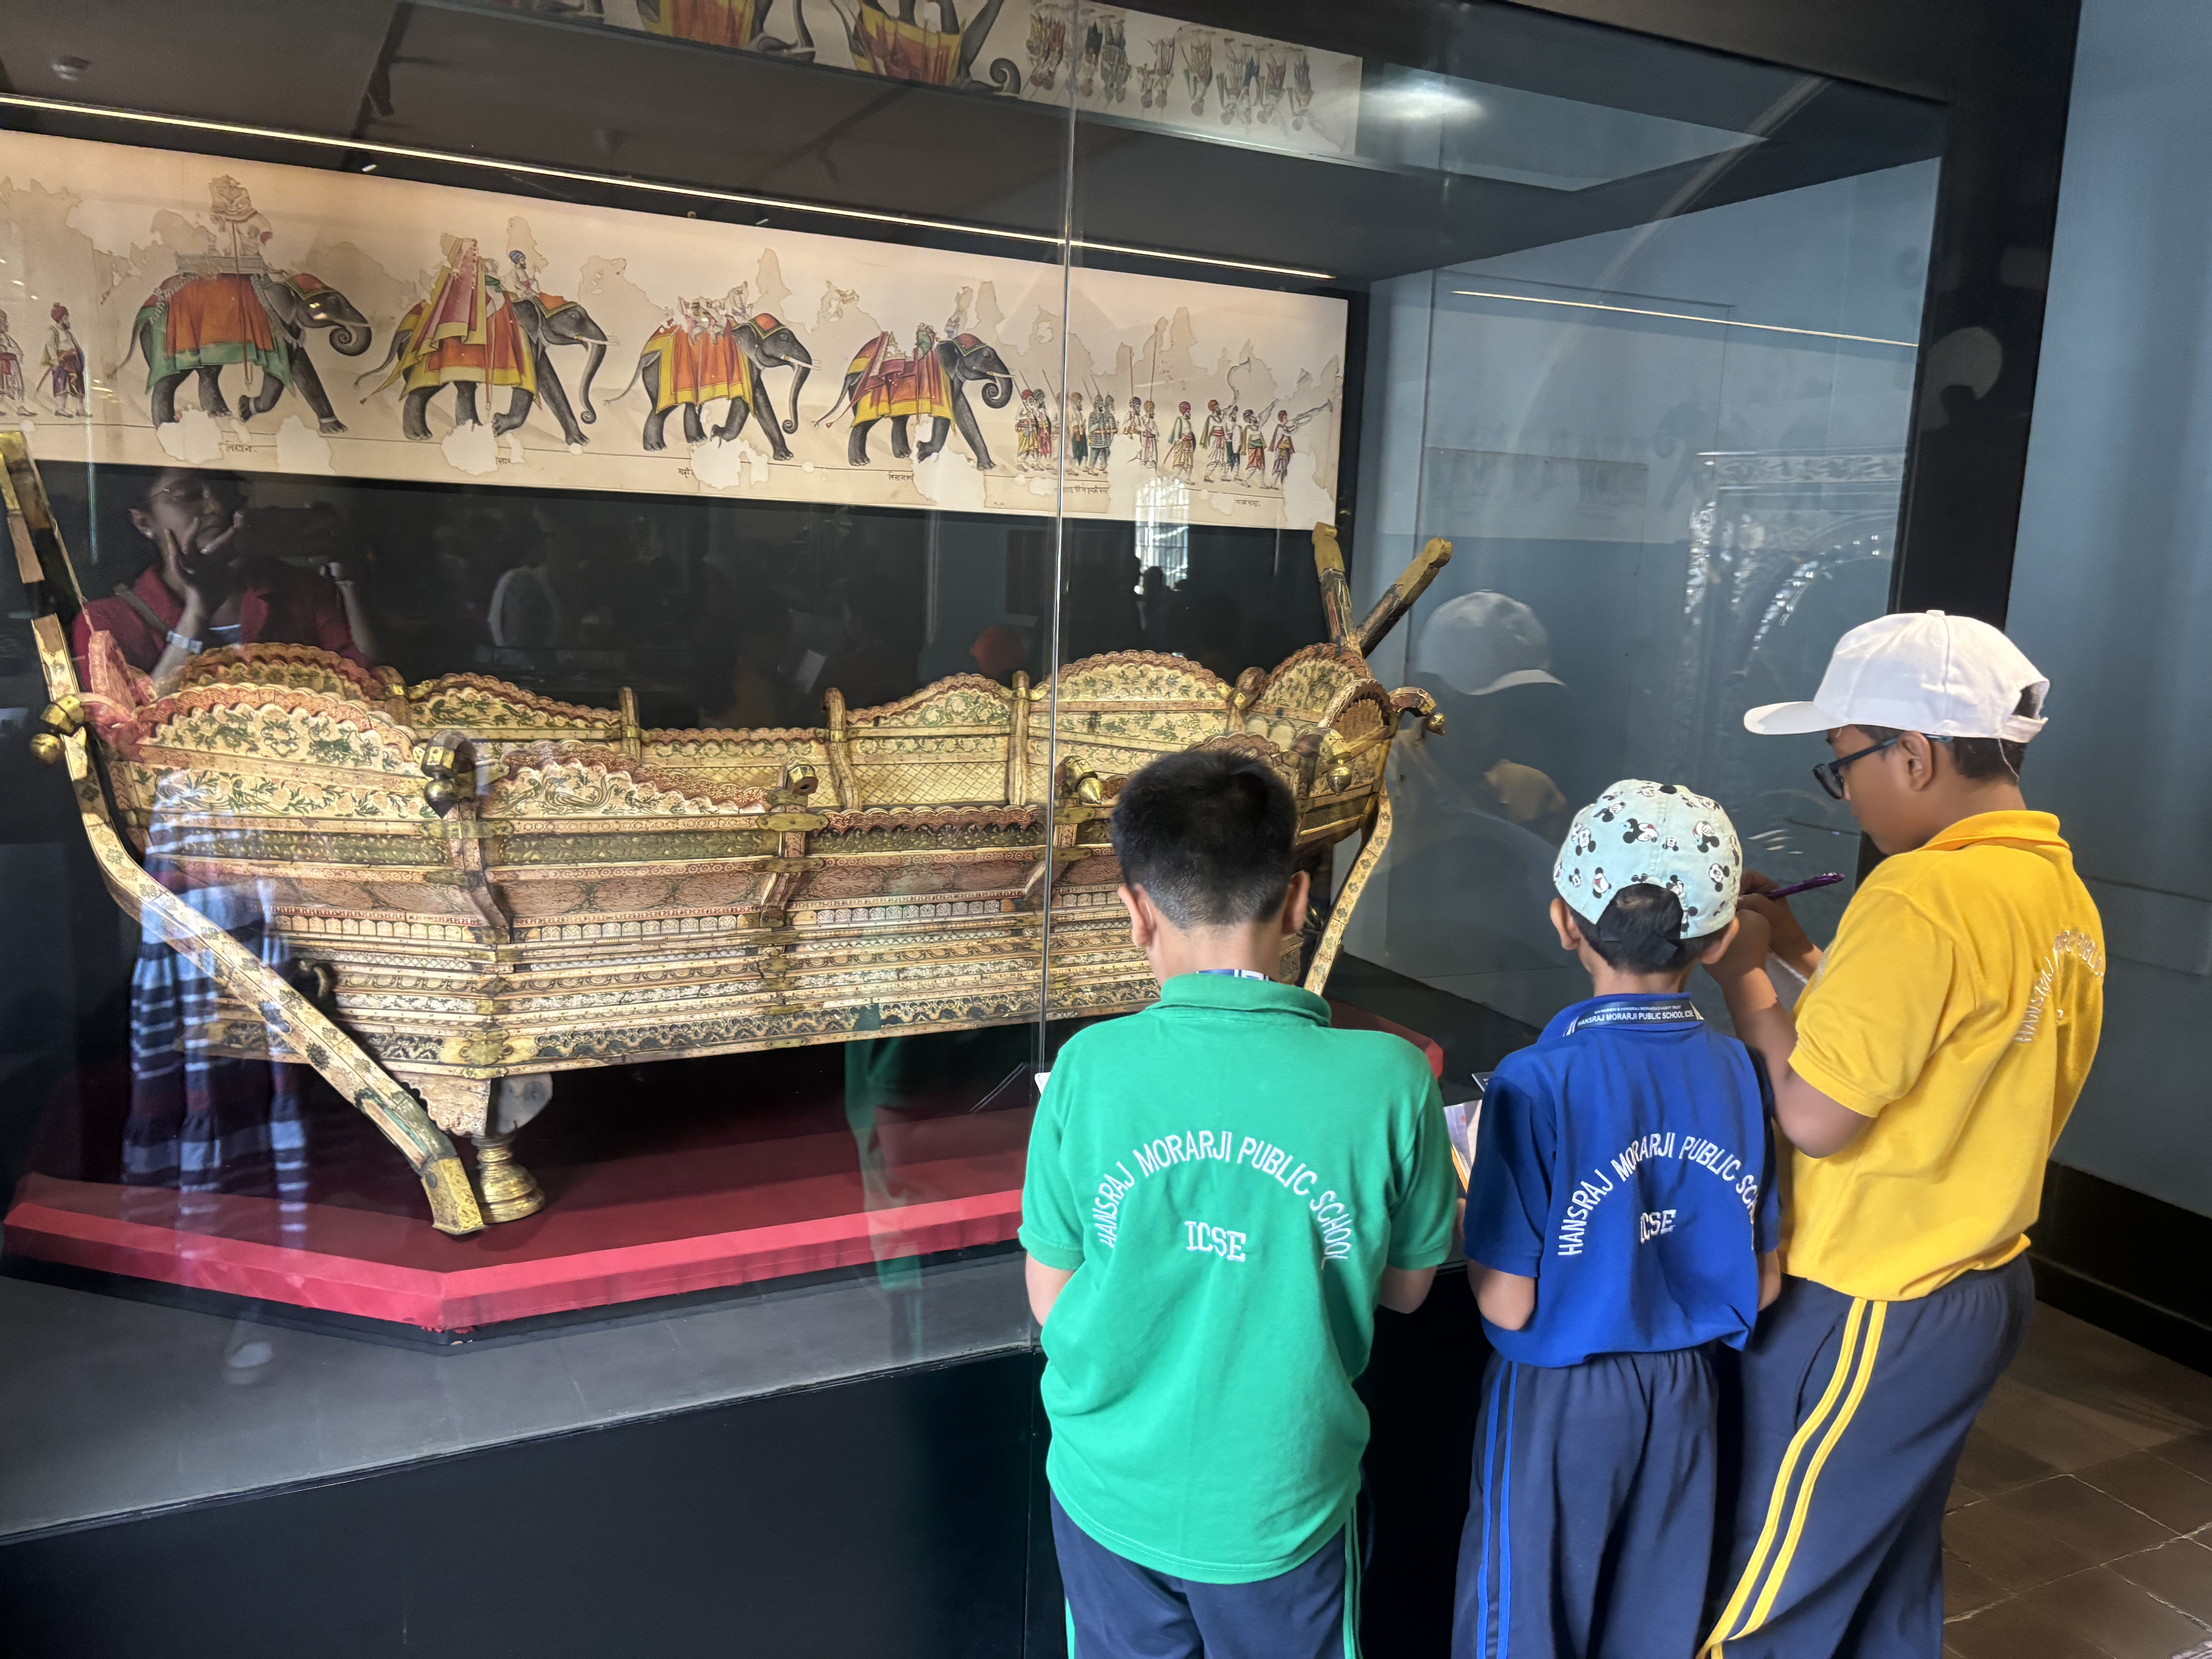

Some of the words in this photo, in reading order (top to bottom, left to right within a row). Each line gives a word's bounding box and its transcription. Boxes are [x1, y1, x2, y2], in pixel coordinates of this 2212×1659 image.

[1577, 1015, 1605, 1026] HANSRAJ
[1662, 1011, 1685, 1019] SCHOOL
[1092, 1161, 1135, 1248] HANSRAJ
[1132, 1130, 1232, 1177] MORARJI
[1237, 1136, 1317, 1196] PUBLIC
[1309, 1190, 1352, 1269] SCHOOL
[1558, 1169, 1613, 1255] HANSRAJ
[1611, 1132, 1676, 1182] MORARJI
[1679, 1136, 1741, 1181] PUBLIC
[1736, 1175, 1758, 1250] SCH
[1185, 1221, 1246, 1262] ICSE
[1640, 1209, 1677, 1244] ICSE
